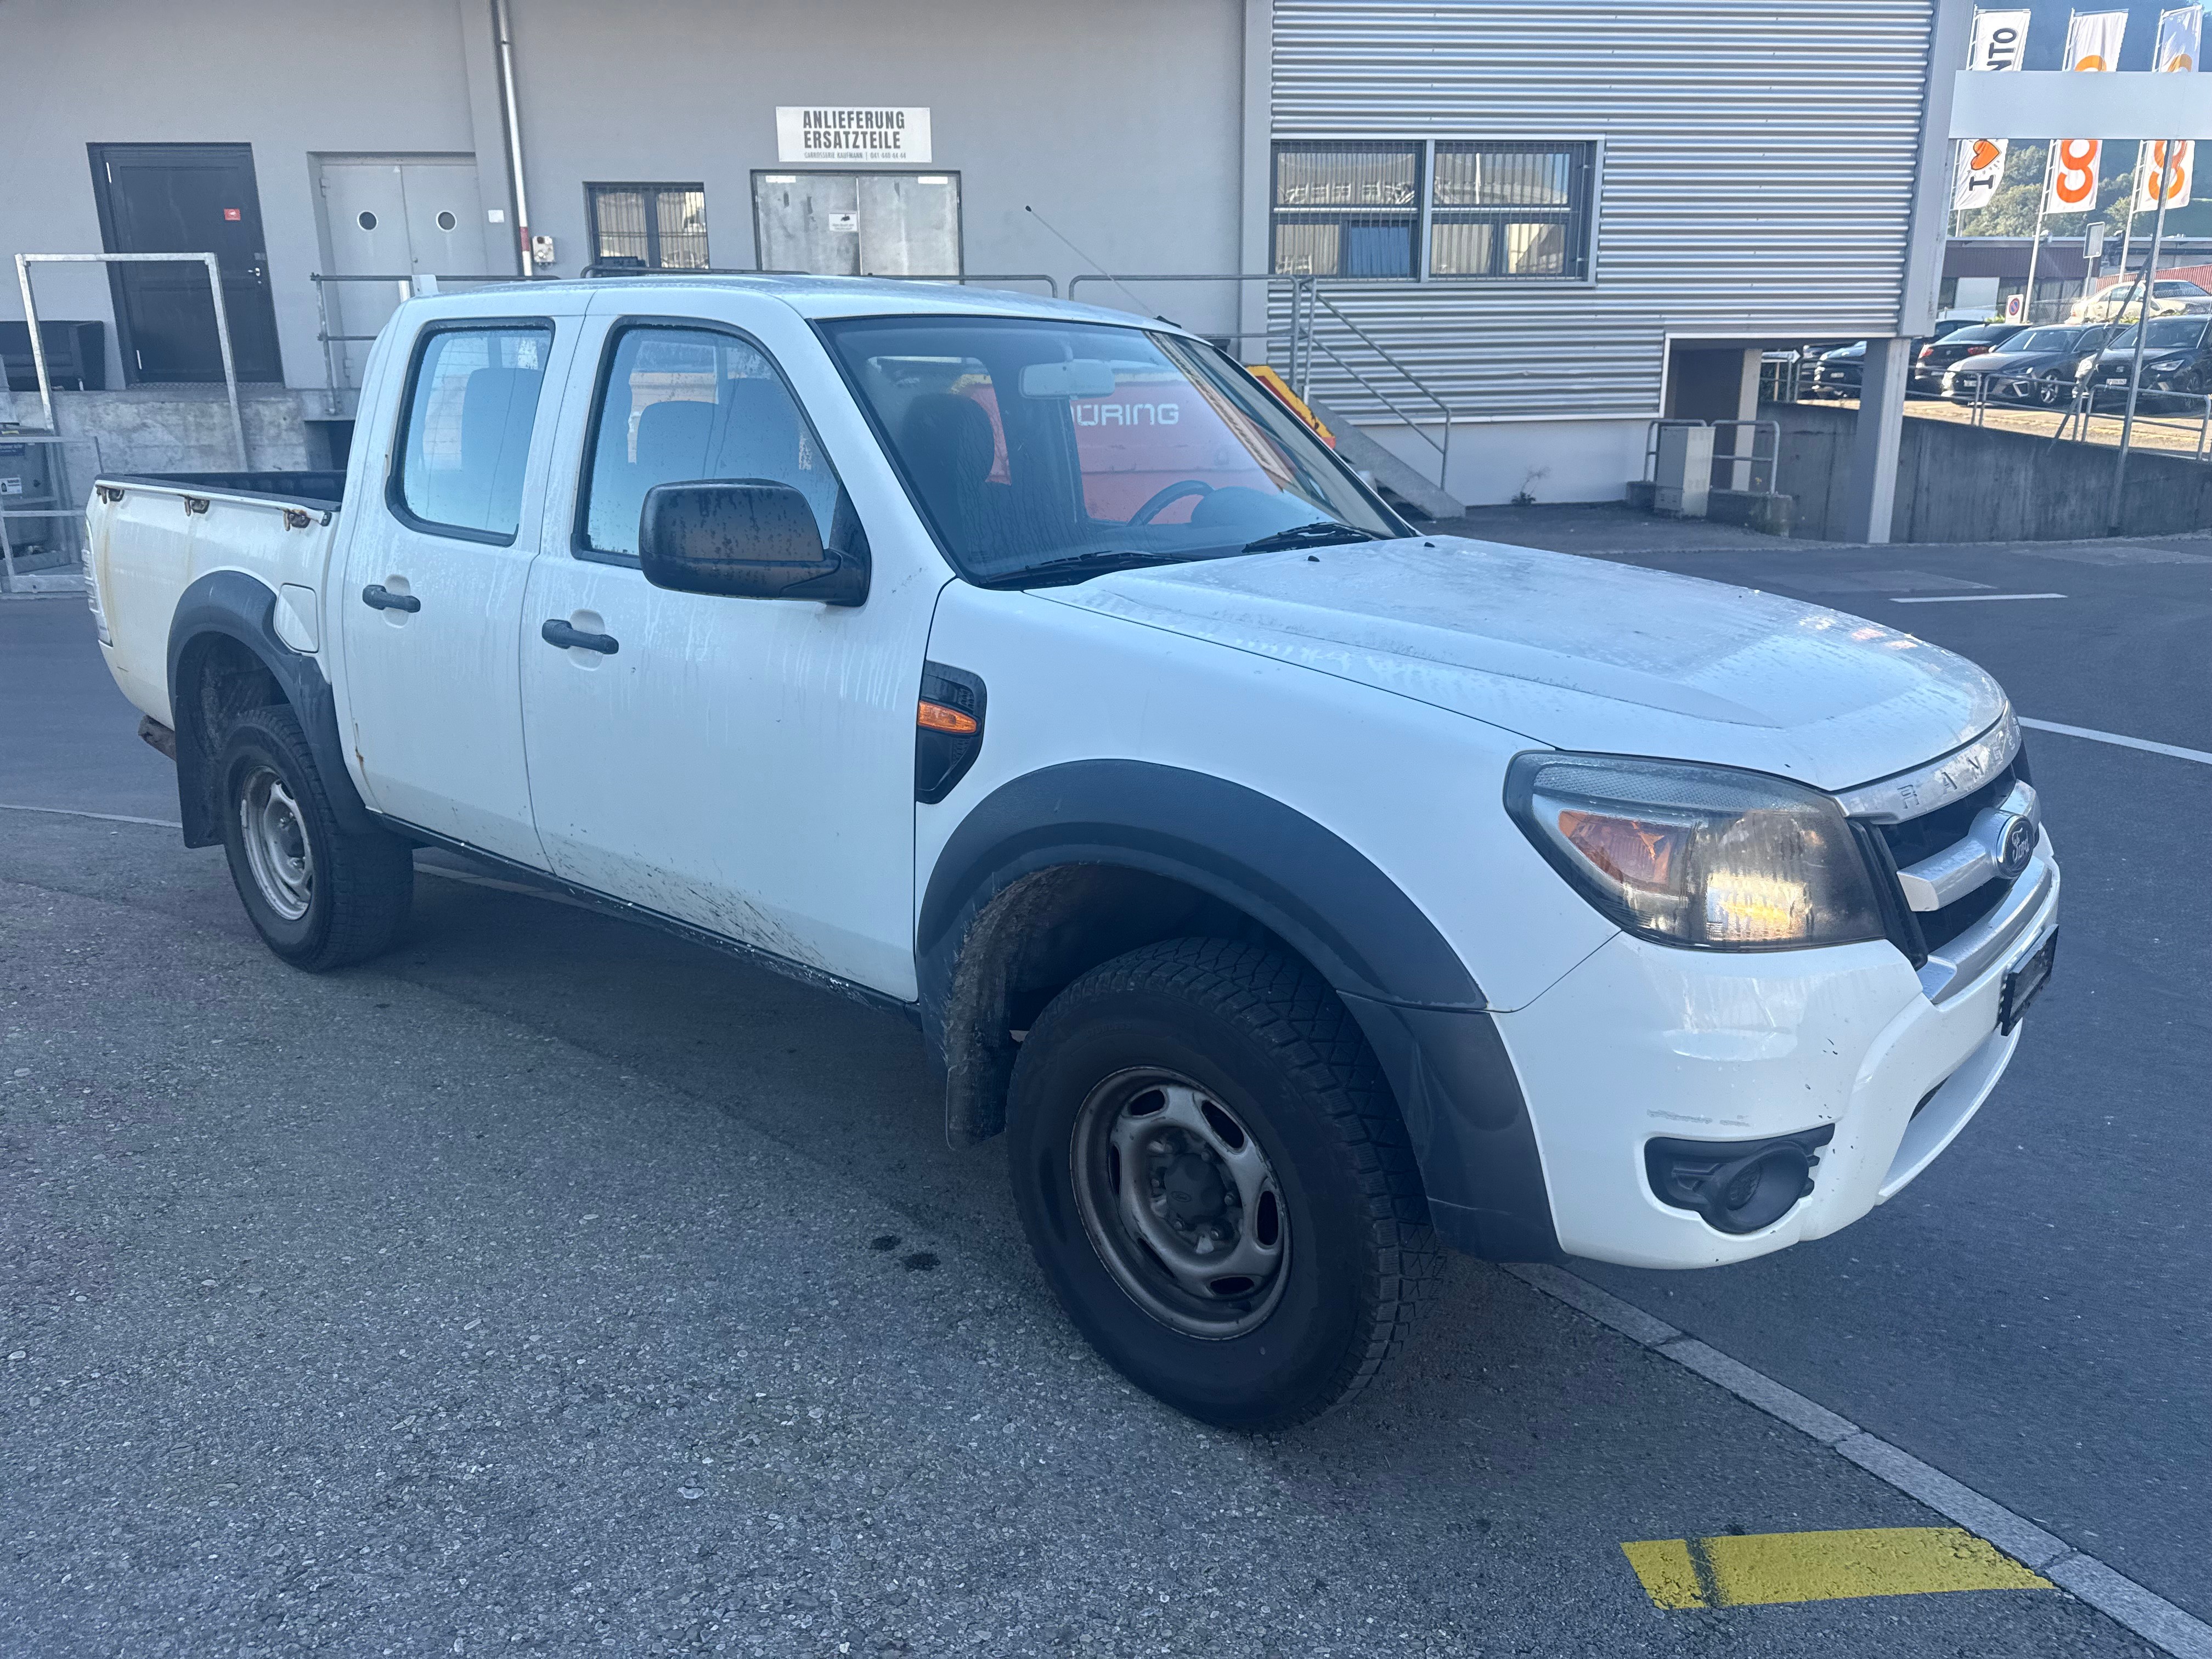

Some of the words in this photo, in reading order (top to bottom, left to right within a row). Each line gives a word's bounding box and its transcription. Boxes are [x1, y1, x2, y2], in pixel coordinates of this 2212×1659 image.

[803, 111, 905, 129] ANLIEFERUNG
[804, 131, 901, 149] ERSATZTEILE
[2012, 827, 2030, 863] Ford
